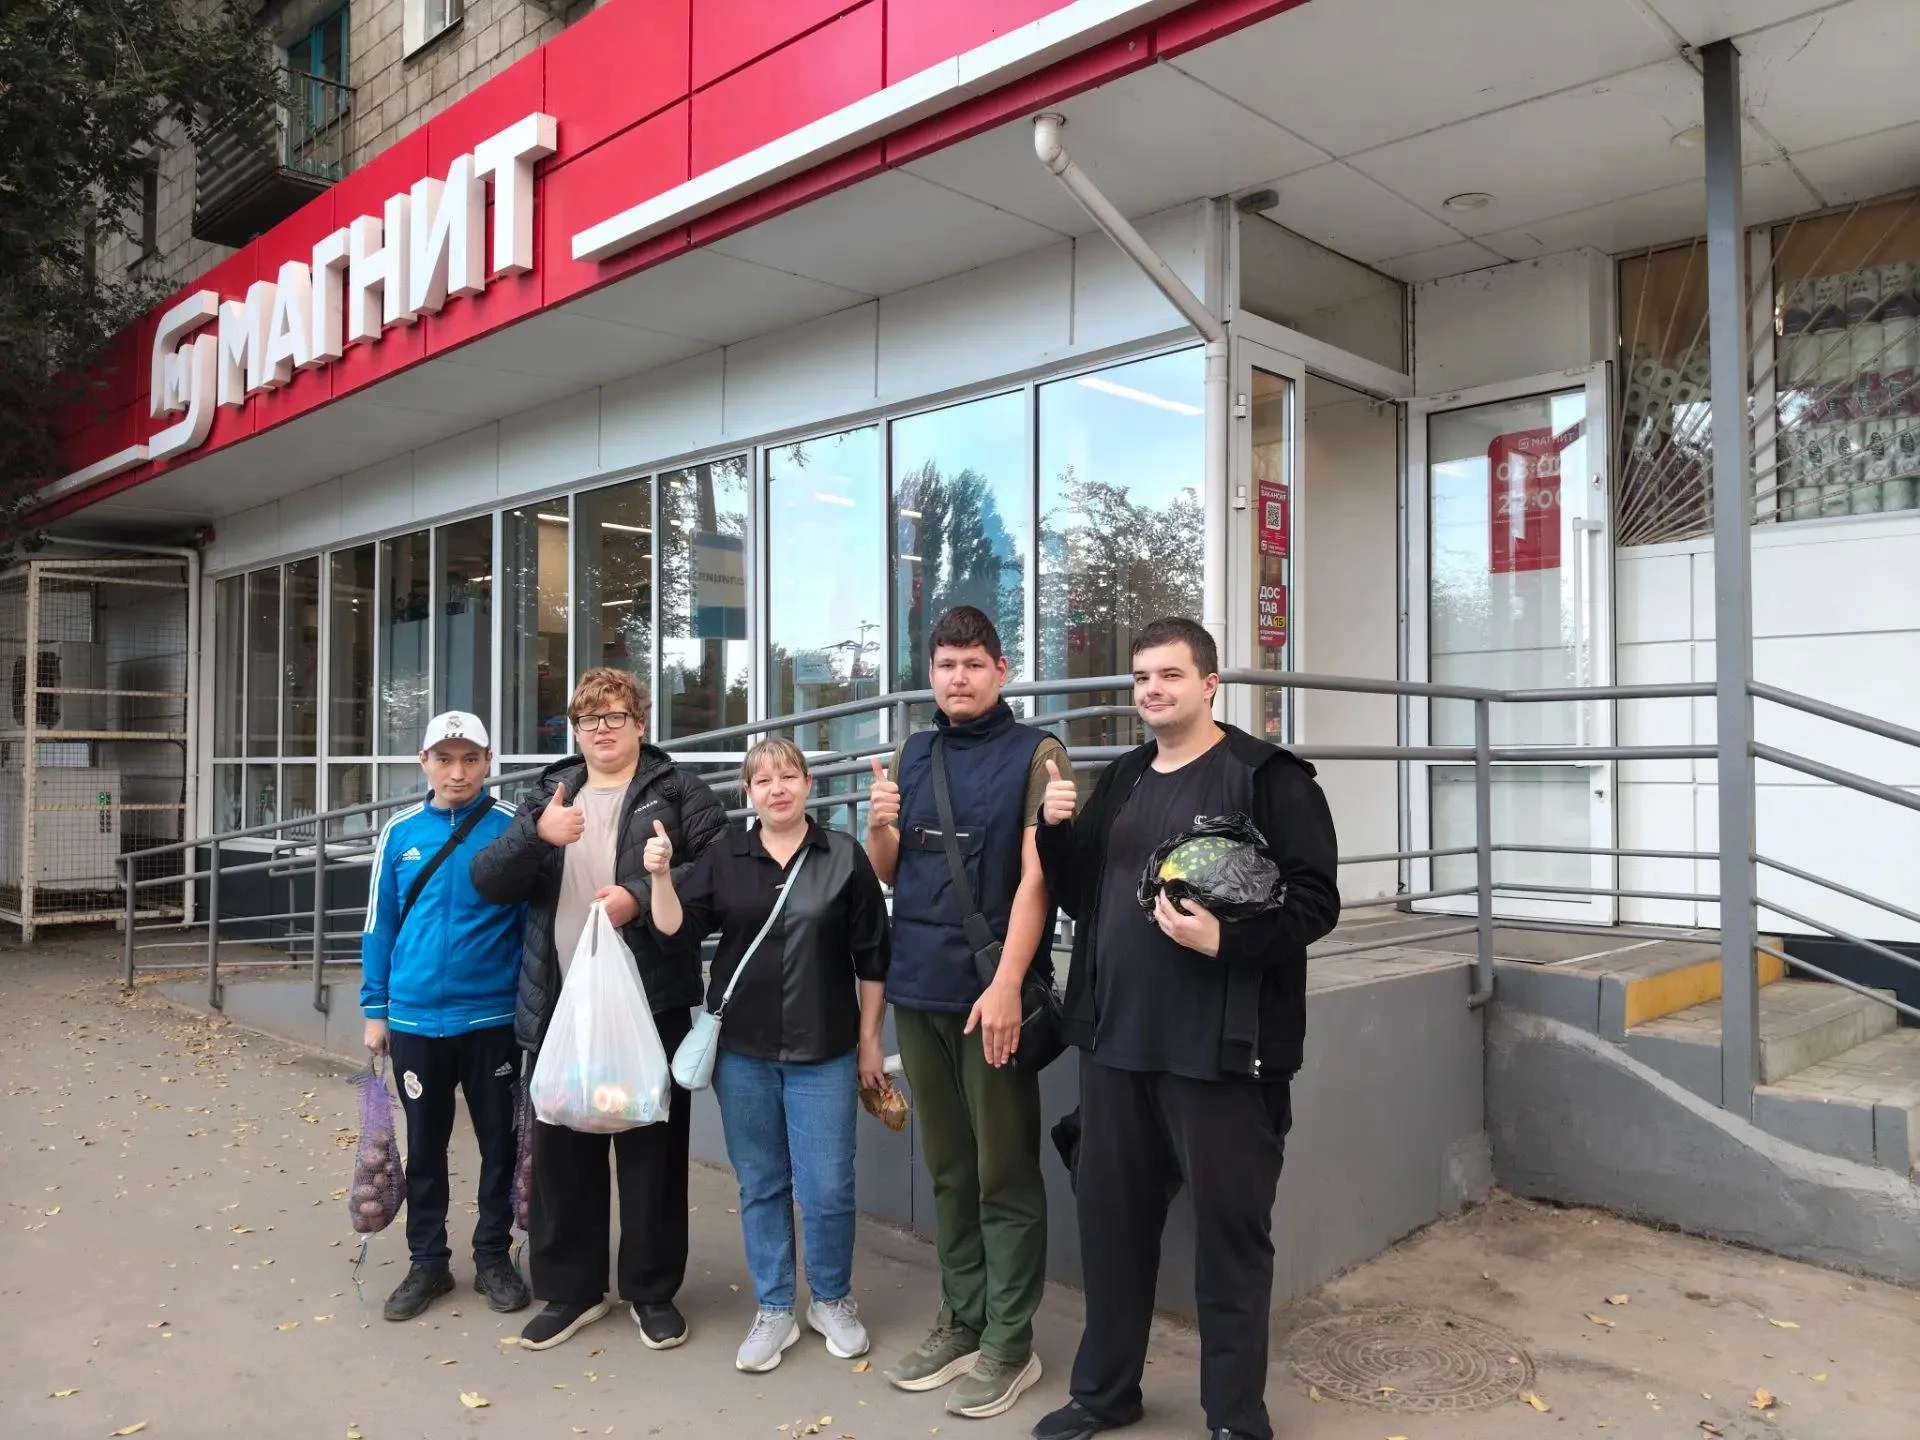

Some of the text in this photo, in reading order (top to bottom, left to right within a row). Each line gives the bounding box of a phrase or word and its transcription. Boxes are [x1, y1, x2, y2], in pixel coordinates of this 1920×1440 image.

[218, 112, 557, 408] МАГНИТ
[1531, 432, 1574, 447] МАГНИТ
[1259, 586, 1281, 600] ДОС
[1259, 601, 1278, 614] ТАВ
[1259, 614, 1273, 627] КА
